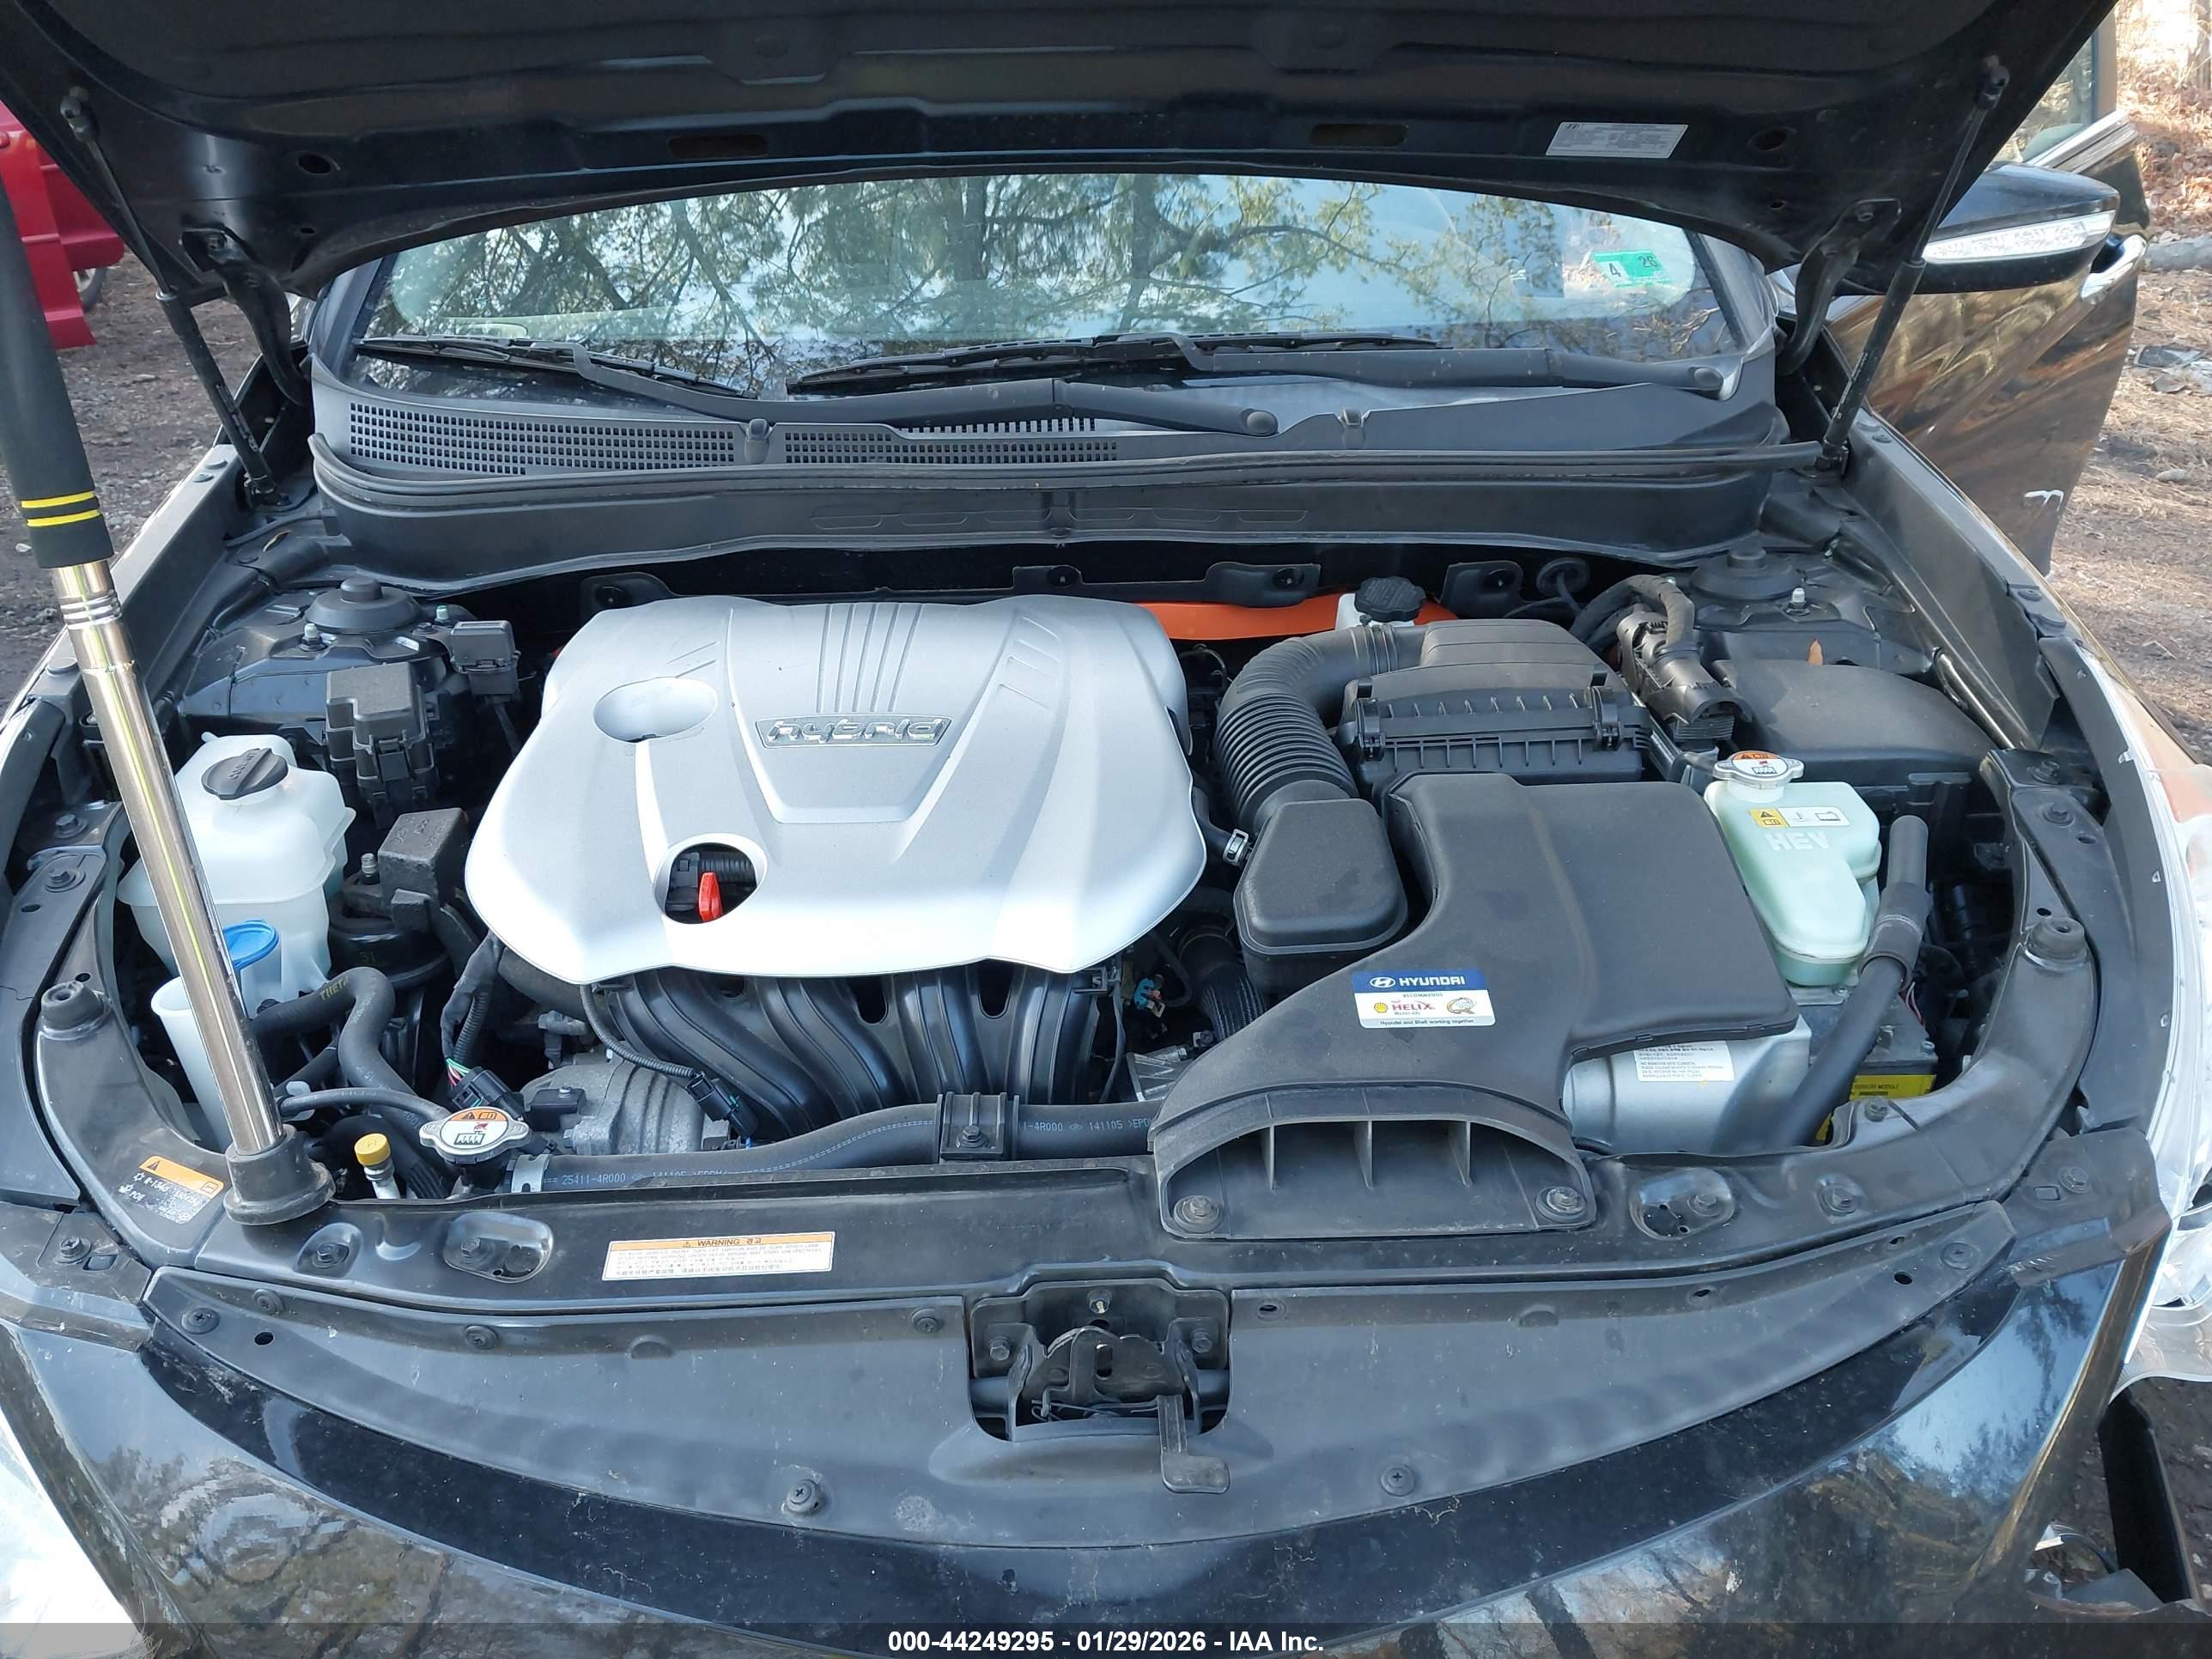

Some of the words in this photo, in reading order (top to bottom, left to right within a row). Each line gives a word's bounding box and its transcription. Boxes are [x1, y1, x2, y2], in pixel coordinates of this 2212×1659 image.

[1638, 255, 1658, 269] 26
[1608, 262, 1622, 277] 4
[1765, 830, 1830, 852] HEV
[1399, 976, 1466, 987] HYUNDAI
[1392, 1001, 1435, 1011] HELIX
[561, 1173, 626, 1185] 25411-4R000
[697, 1238, 740, 1247] WARNING
